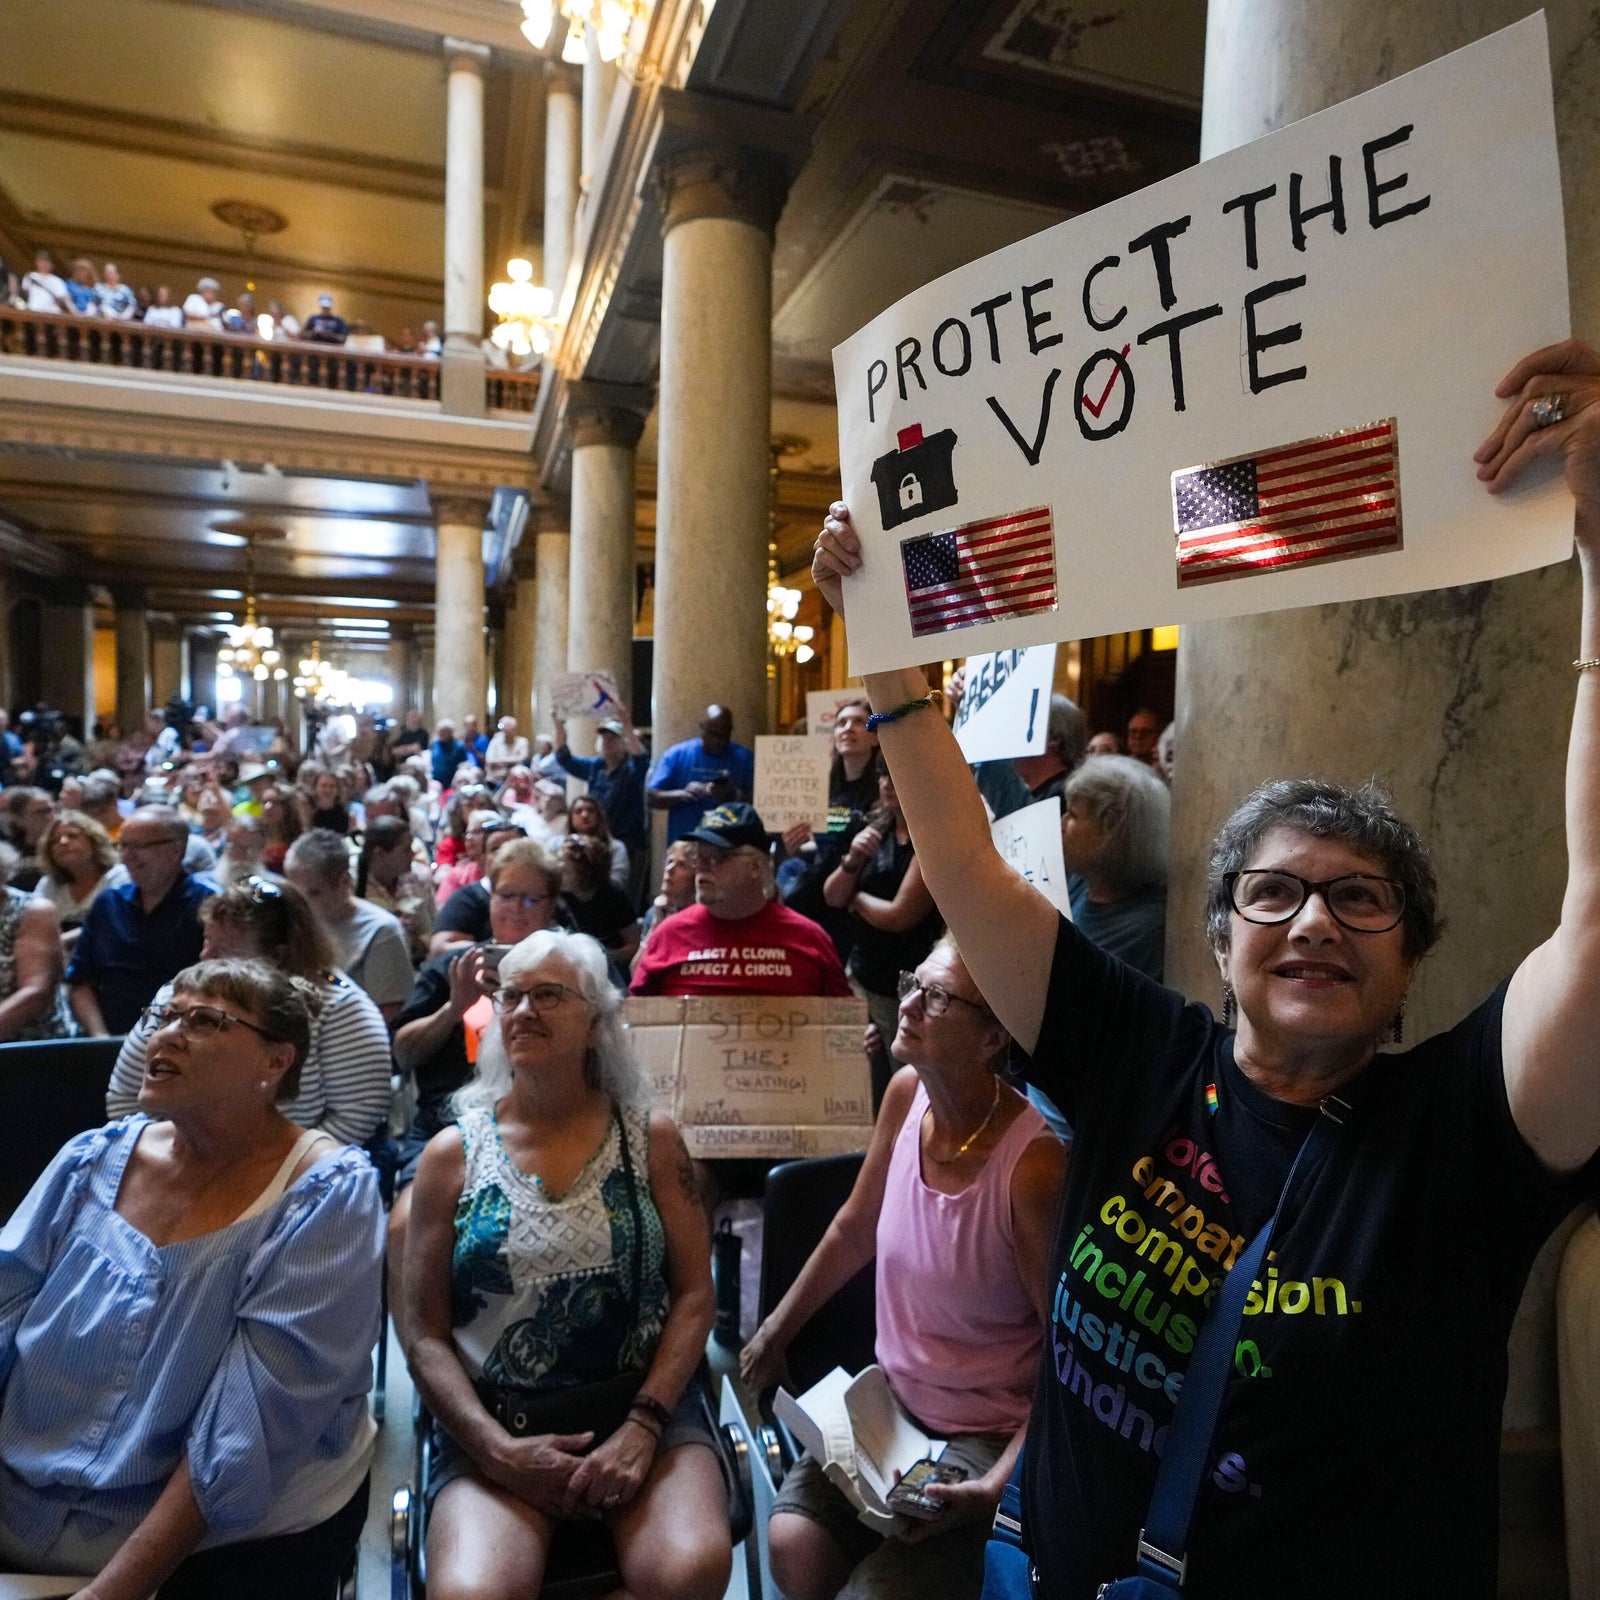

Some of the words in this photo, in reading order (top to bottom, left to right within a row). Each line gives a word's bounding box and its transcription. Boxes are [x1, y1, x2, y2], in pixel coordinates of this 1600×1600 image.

[868, 215, 1191, 423] PROTECT
[1222, 124, 1431, 270] THE
[986, 275, 1307, 466] VOTE
[680, 962, 729, 976] EXPECT
[732, 963, 742, 976] A
[744, 963, 793, 977] CIRCUS
[687, 947, 726, 961] ELECT
[729, 947, 740, 960] A
[742, 947, 787, 961] CLOWN
[707, 1011, 809, 1041] STOP
[1069, 1223, 1273, 1378] inclusn.
[1099, 1194, 1362, 1316] compsion.
[1052, 1323, 1262, 1499] kindns.
